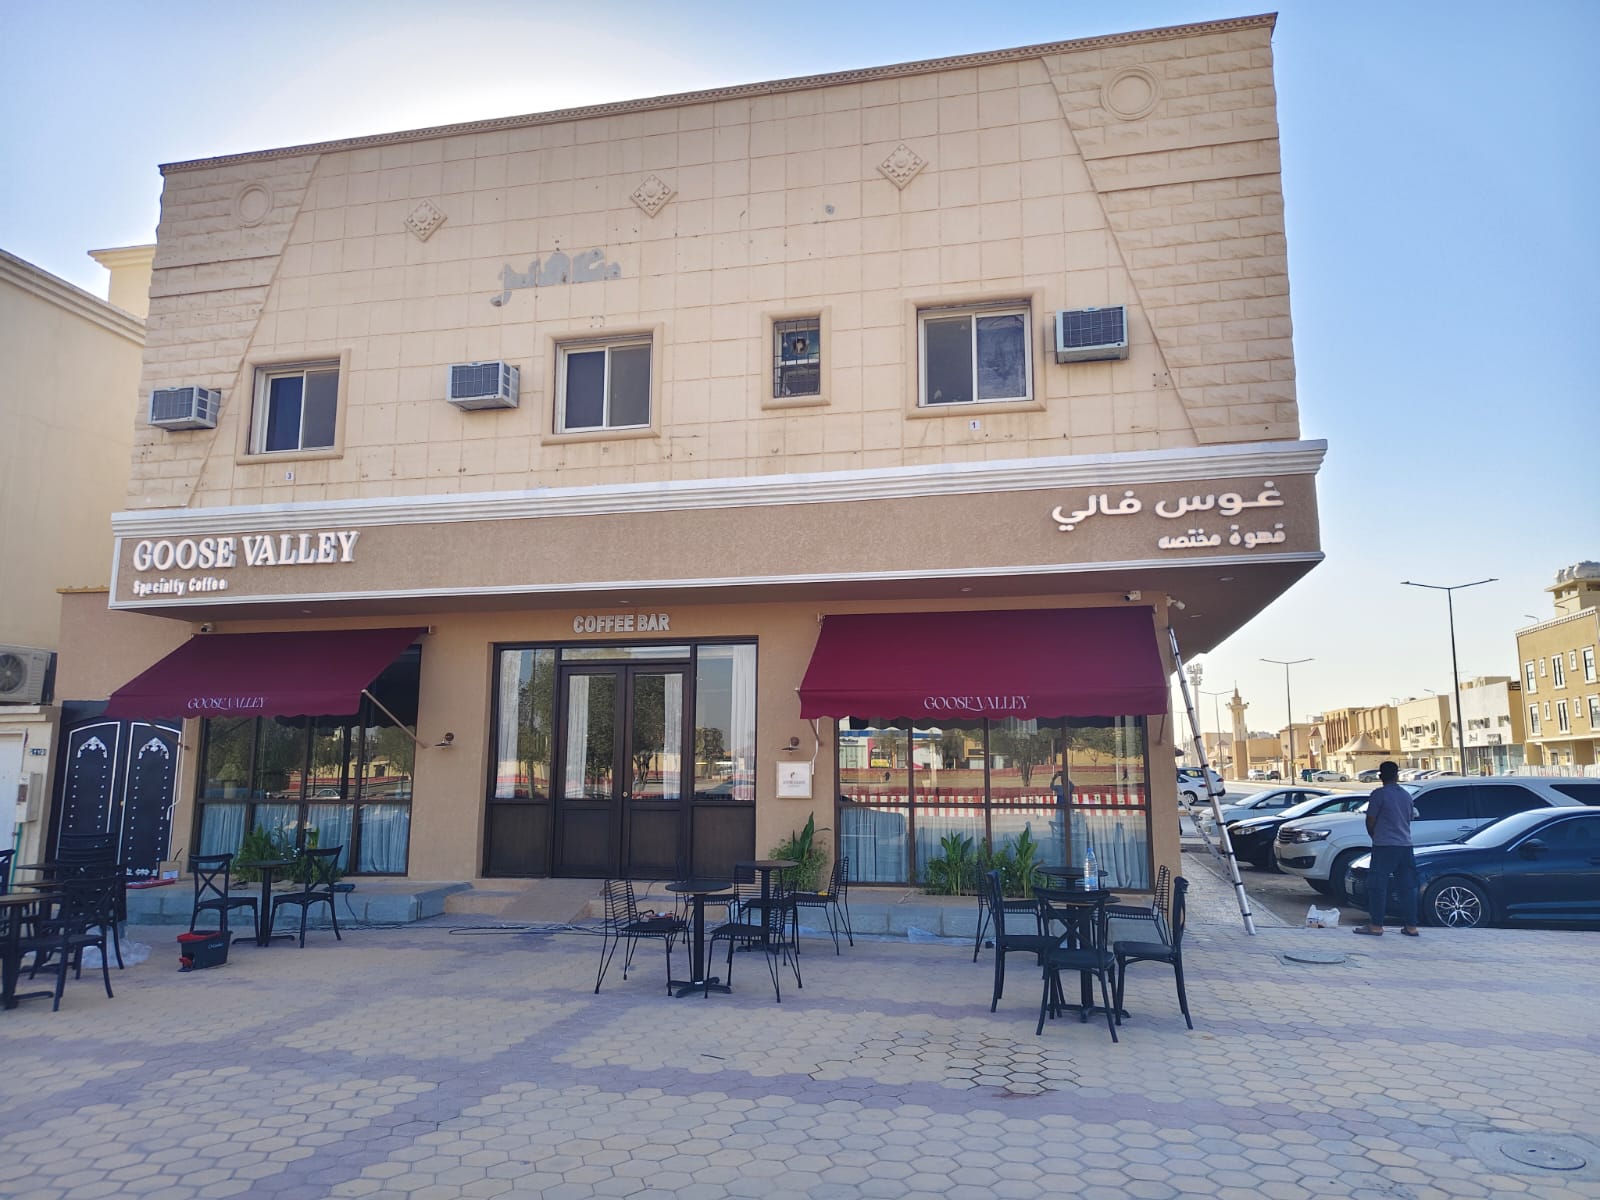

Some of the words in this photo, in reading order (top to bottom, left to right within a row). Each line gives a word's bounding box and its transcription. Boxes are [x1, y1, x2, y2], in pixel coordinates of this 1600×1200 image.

[971, 421, 977, 429] 1
[1154, 480, 1286, 519] غوس
[1051, 490, 1143, 532] فالي
[1229, 522, 1287, 550] قهوة
[133, 536, 237, 571] GOOSE
[242, 530, 360, 567] VALLEY
[132, 577, 186, 597] Specialty
[188, 576, 228, 593] Coffee
[573, 614, 634, 633] COFFEE
[637, 613, 670, 632] BAR
[187, 697, 226, 710] GOOSE
[924, 696, 974, 711] GOOSE
[975, 696, 1030, 710] VALLEY
